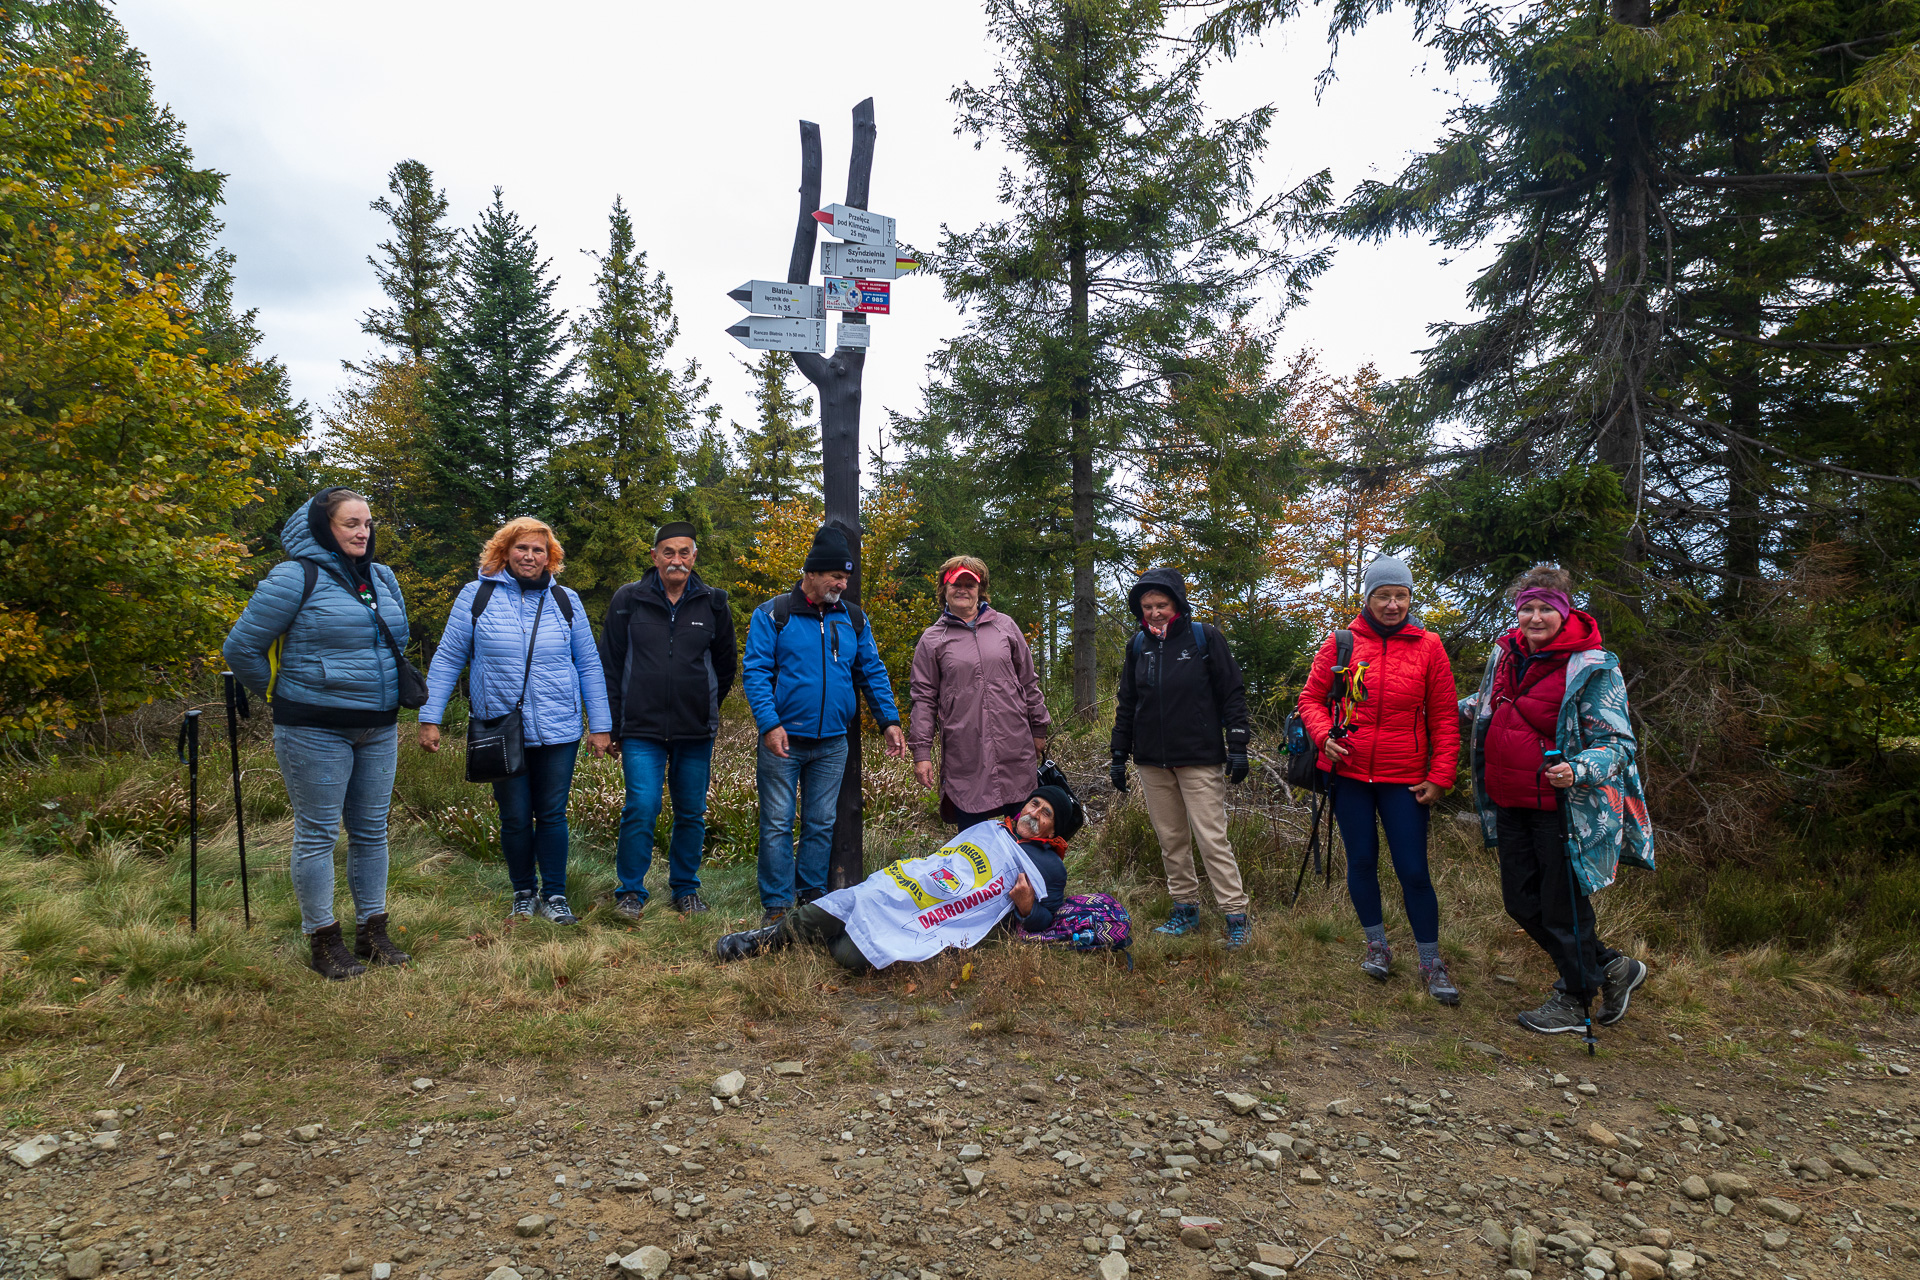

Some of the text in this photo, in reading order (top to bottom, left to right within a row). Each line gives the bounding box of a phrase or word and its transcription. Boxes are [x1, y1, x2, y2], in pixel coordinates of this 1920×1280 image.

[848, 213, 870, 224] Przełęcz
[837, 219, 880, 235] pod Klimczokiem
[850, 229, 867, 239] 25 min
[847, 249, 885, 258] Szyndzielnia
[771, 287, 793, 295] Błatnia
[917, 876, 1006, 930] DĄBROWIACY
